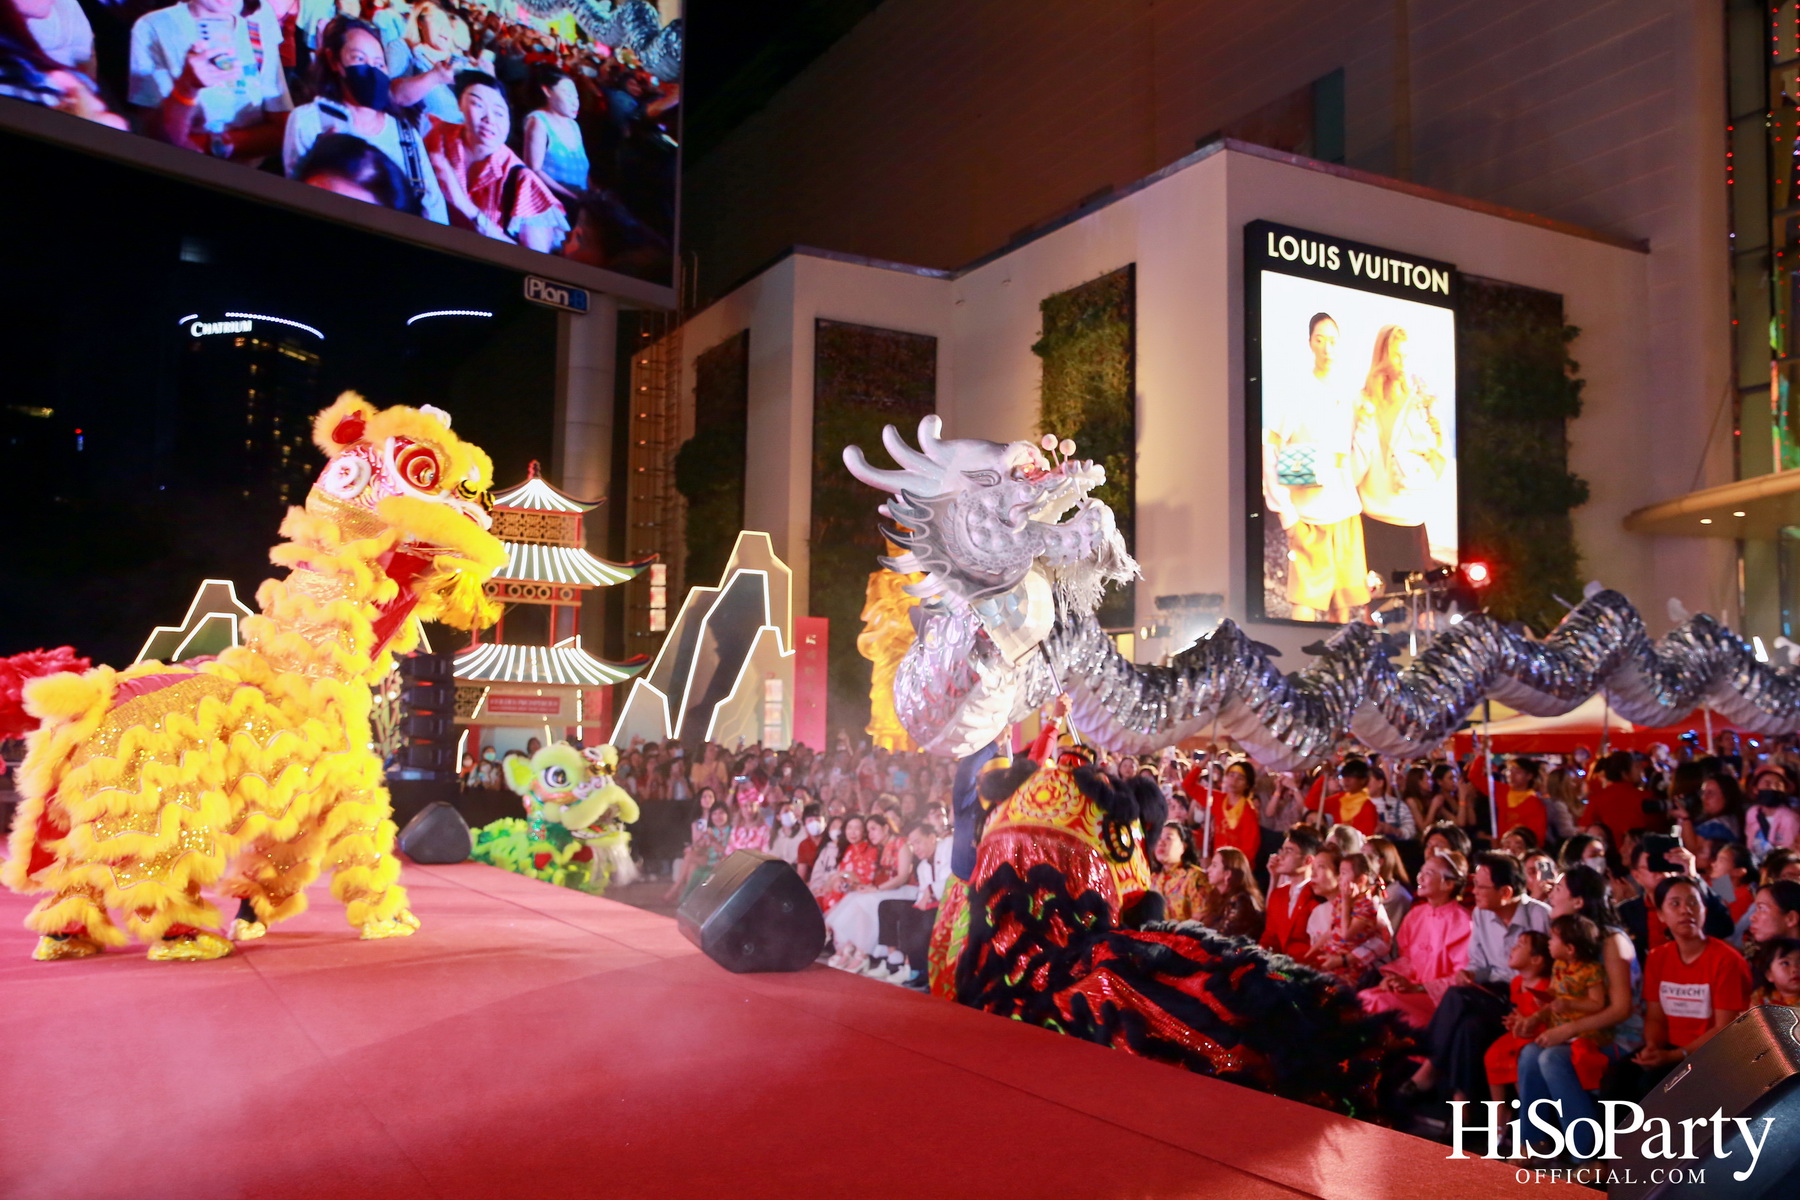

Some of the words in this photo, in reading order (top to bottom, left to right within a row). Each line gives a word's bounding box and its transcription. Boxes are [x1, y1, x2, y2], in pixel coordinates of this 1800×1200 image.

[1267, 231, 1341, 271] LOUIS
[1347, 249, 1450, 296] VUITTON
[529, 278, 569, 306] Plan
[190, 320, 253, 337] CHATRIUM
